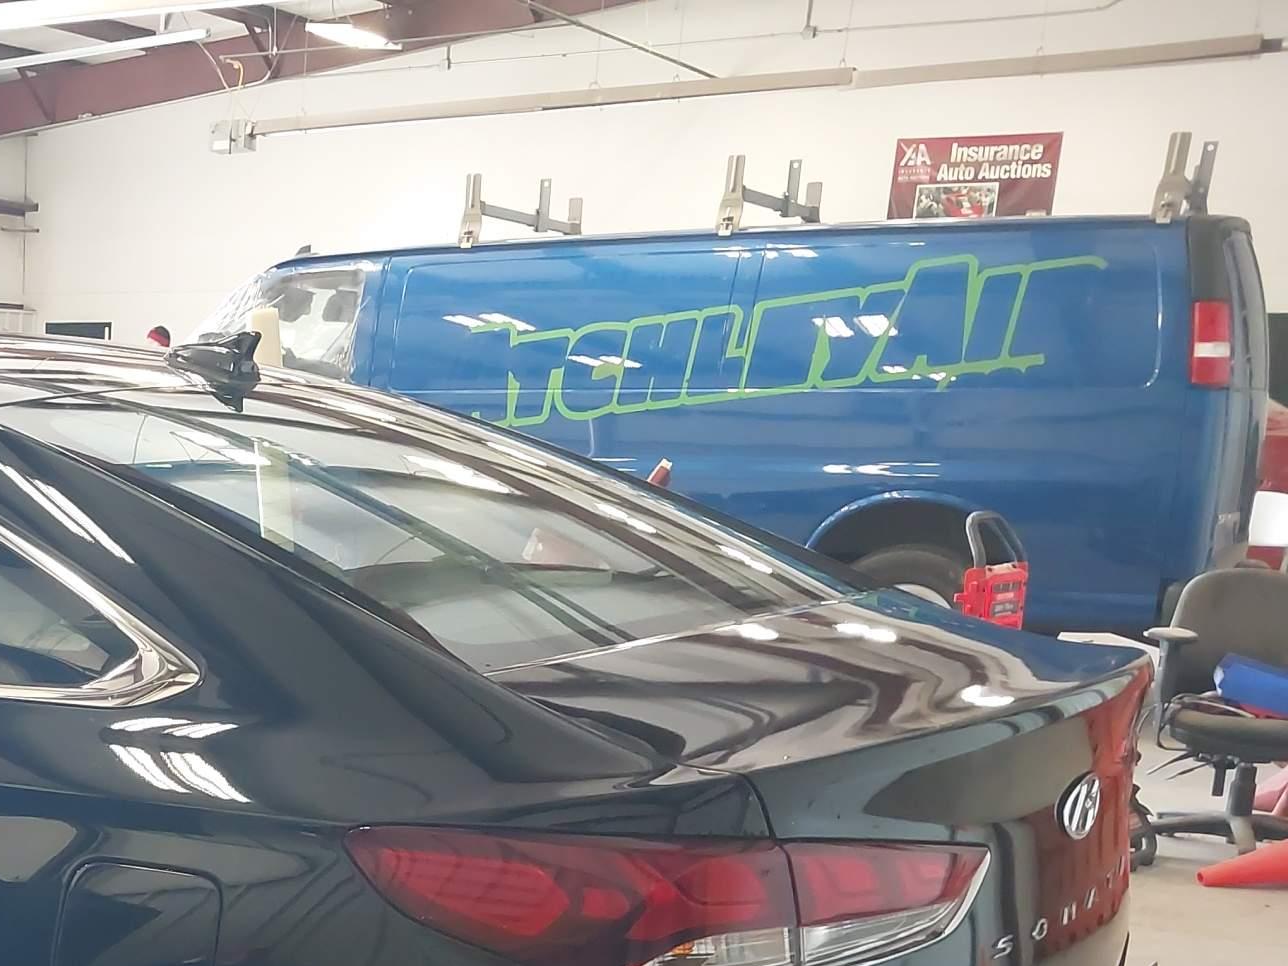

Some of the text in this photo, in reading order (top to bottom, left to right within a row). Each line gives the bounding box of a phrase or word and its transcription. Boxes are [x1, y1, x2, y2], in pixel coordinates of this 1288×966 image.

[950, 142, 1044, 163] Insurance
[936, 160, 1052, 182] Auto Auctions
